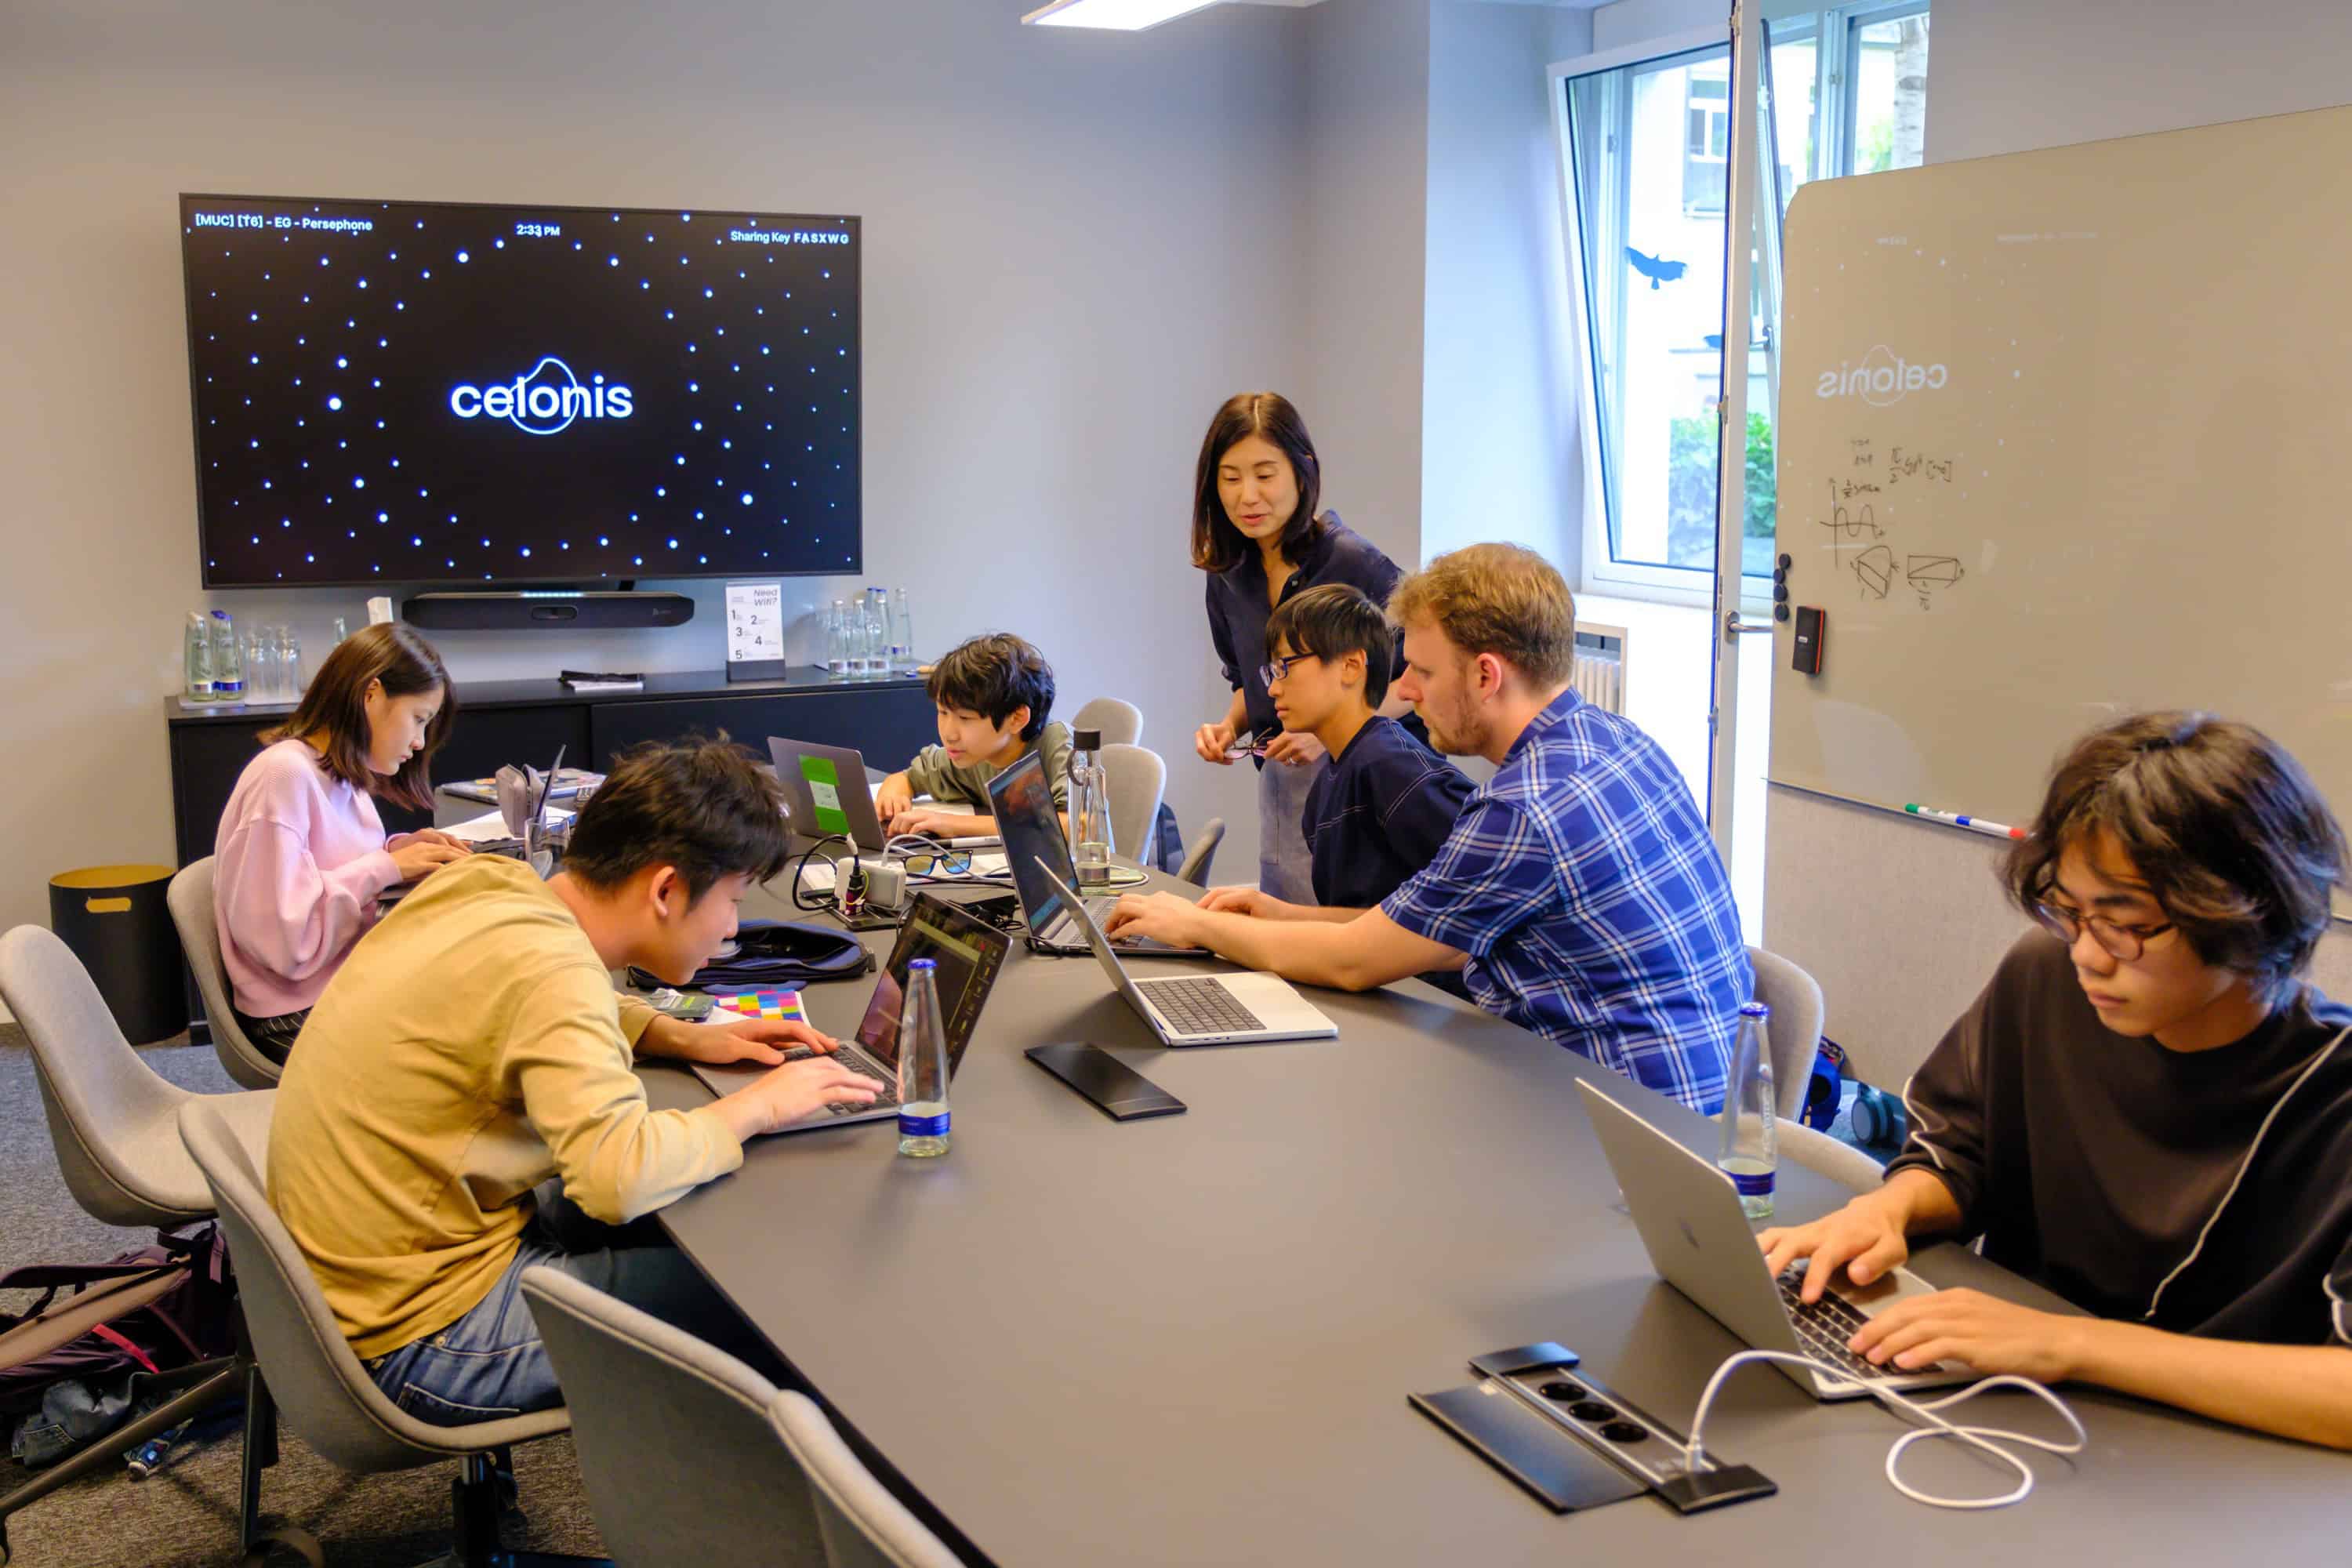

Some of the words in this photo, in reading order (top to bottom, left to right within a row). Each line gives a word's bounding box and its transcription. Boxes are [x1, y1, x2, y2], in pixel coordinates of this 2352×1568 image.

[195, 213, 234, 227] [MUC]
[238, 214, 263, 228] [T6]
[274, 217, 292, 228] EG
[302, 218, 373, 232] Persephone
[517, 224, 542, 236] 2:33
[544, 225, 561, 236] PM
[731, 230, 770, 244] Sharing
[771, 232, 790, 245] Key
[451, 375, 633, 418] celonis
[731, 609, 736, 620] 1
[750, 615, 757, 625] 2
[735, 626, 742, 637] 3
[754, 636, 762, 646] 4
[735, 649, 742, 659] 5
